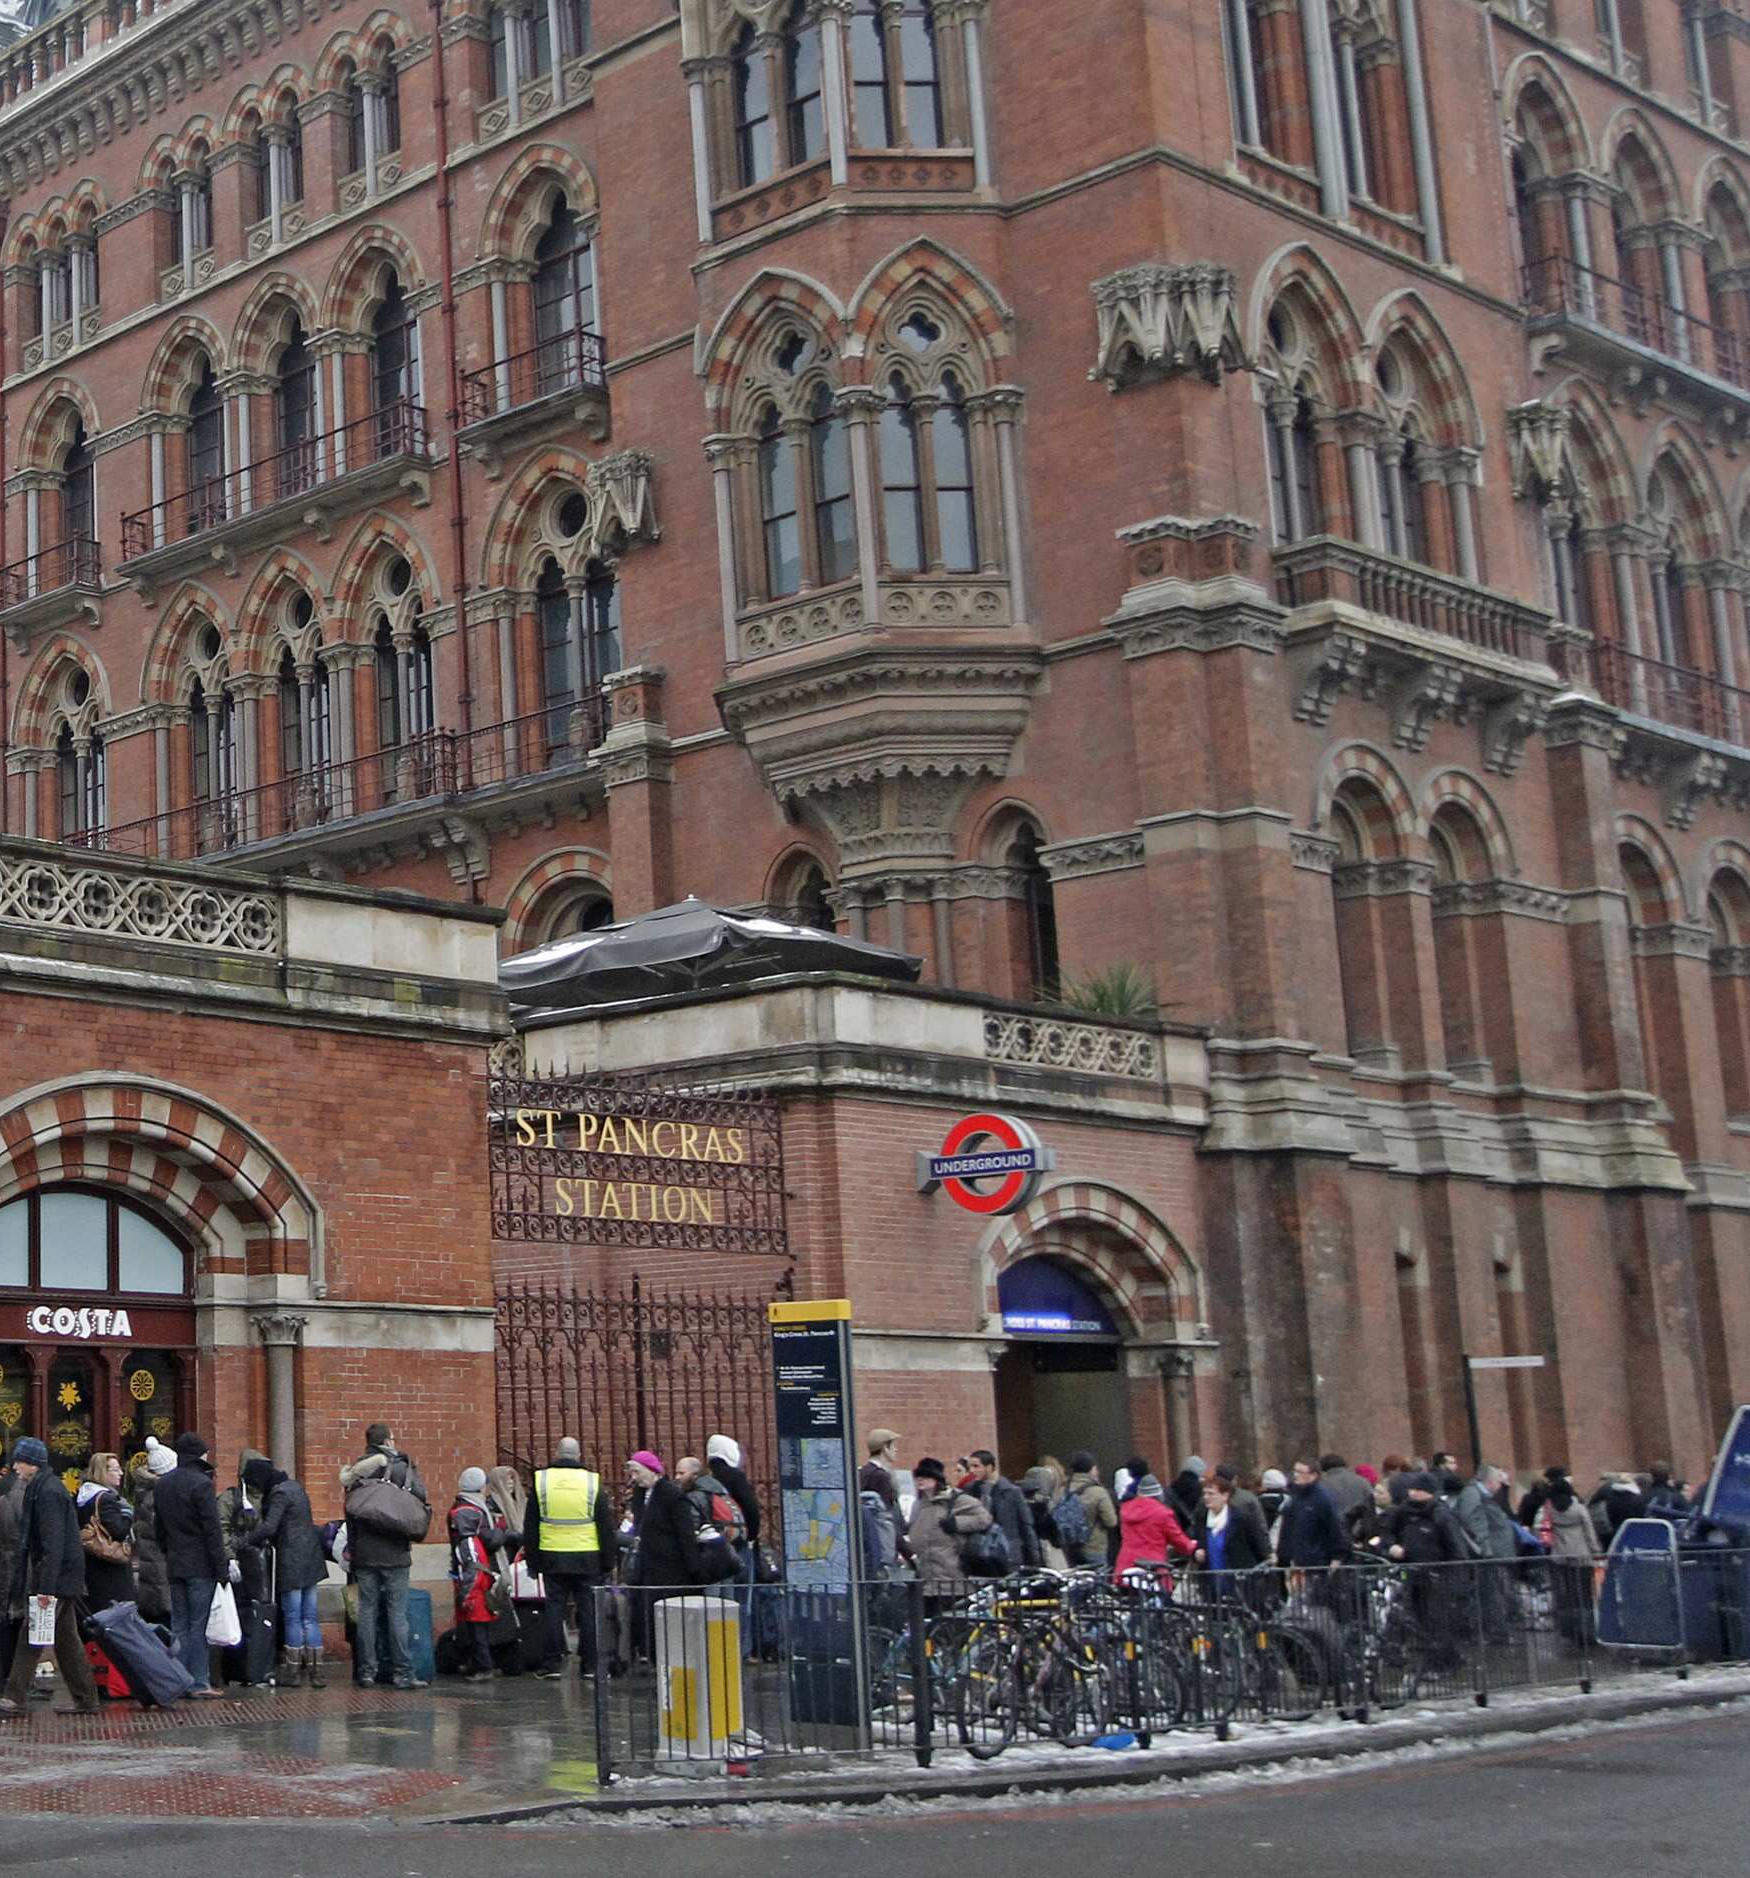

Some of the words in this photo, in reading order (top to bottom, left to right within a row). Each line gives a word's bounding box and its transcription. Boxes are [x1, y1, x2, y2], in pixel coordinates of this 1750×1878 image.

[516, 1108, 561, 1148] ST
[578, 1113, 743, 1163] PANCRAS
[934, 1154, 1031, 1174] UNDERGROUND
[555, 1177, 713, 1224] STATION
[27, 1306, 132, 1338] COSTA
